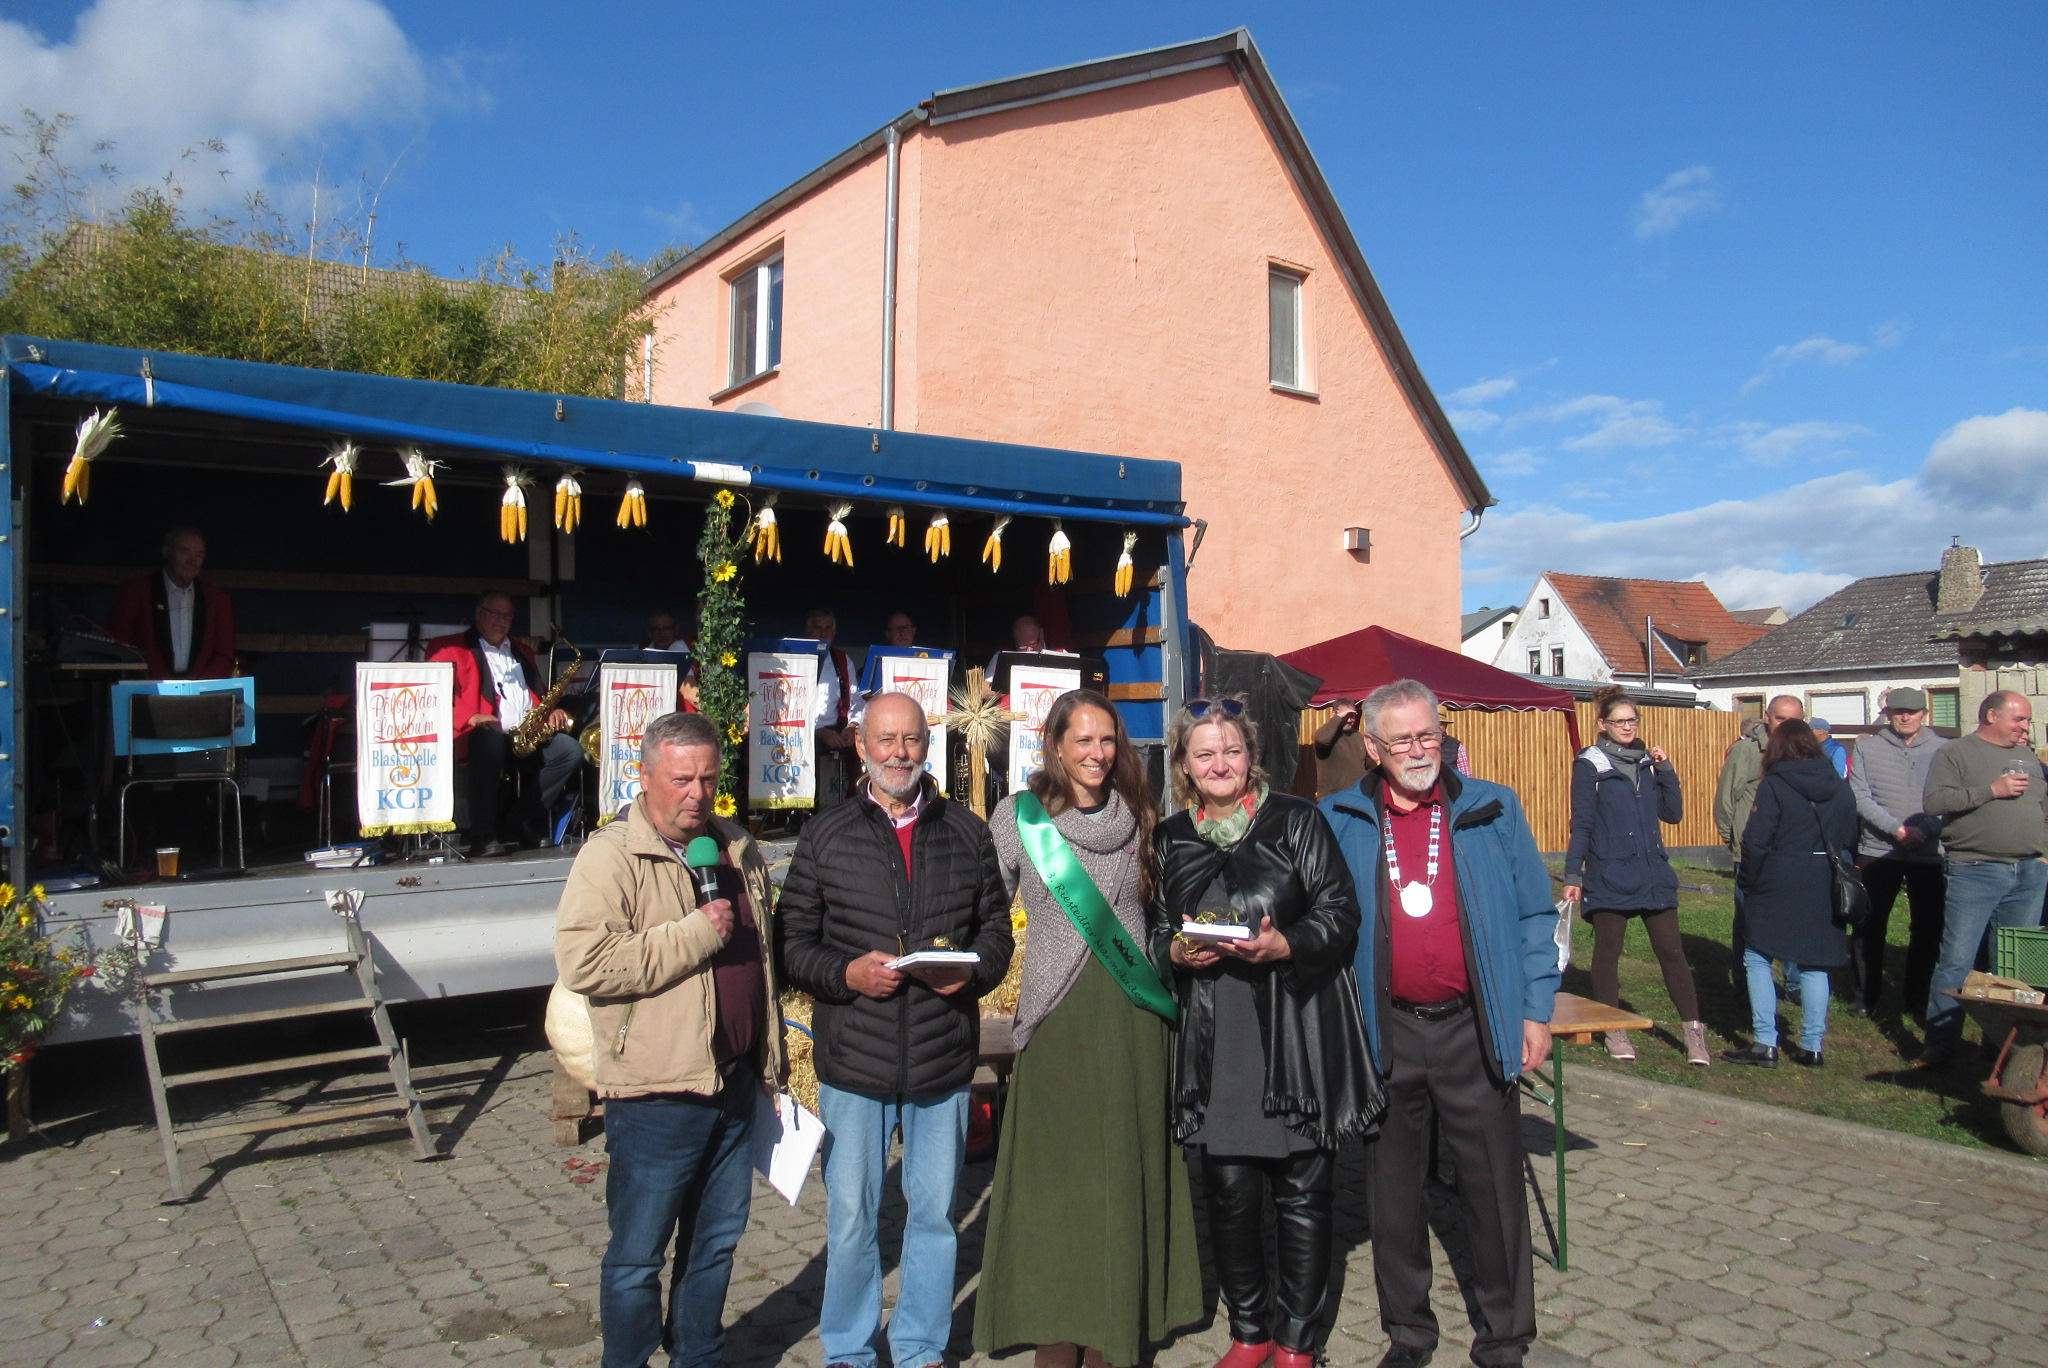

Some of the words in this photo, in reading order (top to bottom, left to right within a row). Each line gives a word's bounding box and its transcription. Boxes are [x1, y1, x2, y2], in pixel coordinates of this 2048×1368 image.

[372, 748, 437, 770] Blaskapelle
[611, 744, 642, 760] Blaska
[392, 770, 417, 782] des
[625, 764, 641, 775] de
[762, 764, 801, 784] KCP
[376, 787, 433, 810] KCP
[611, 780, 641, 800] KC
[1047, 872, 1055, 883] 3.
[1055, 882, 1097, 937] Riestedter
